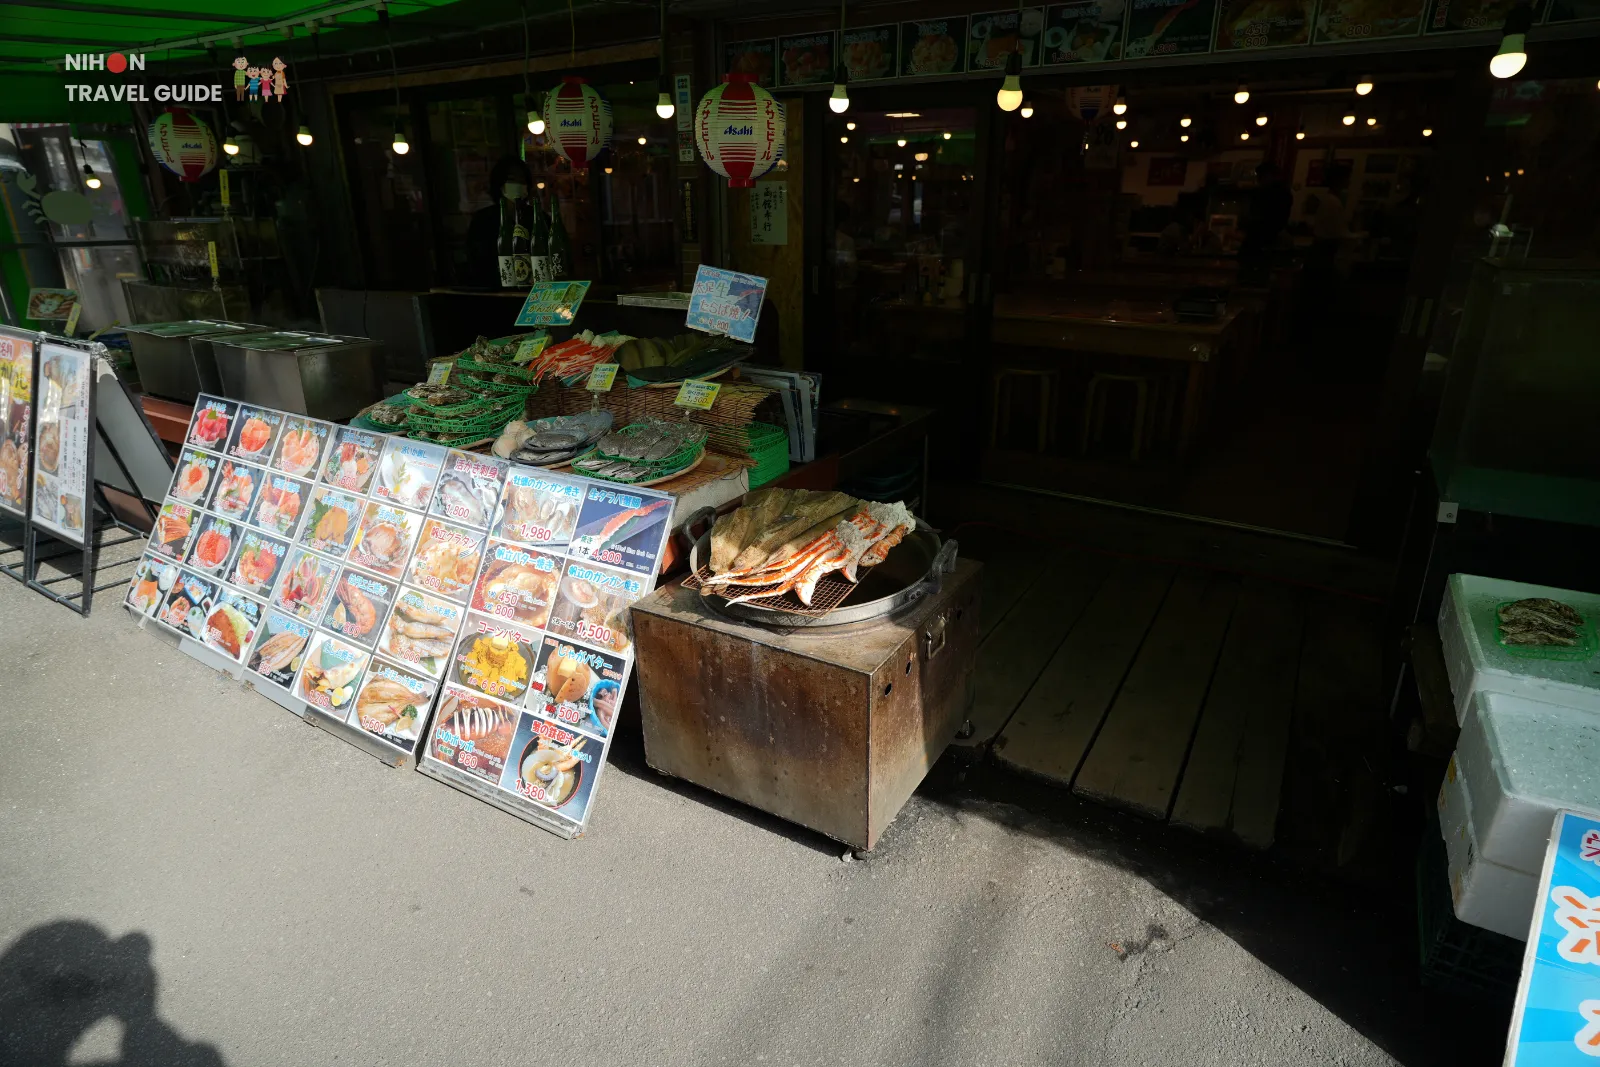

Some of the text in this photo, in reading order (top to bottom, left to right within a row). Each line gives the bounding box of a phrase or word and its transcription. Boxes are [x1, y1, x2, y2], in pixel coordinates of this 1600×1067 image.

[1245, 24, 1270, 36] 450
[1346, 25, 1371, 37] 800
[1464, 17, 1487, 27] 980
[1245, 35, 1268, 47] 800
[560, 119, 582, 127] Asahi
[588, 96, 601, 145] アサヒビール
[701, 99, 715, 161] アサヒビール
[761, 99, 776, 161] アサヒビール
[724, 125, 753, 136] Asahi
[455, 458, 499, 479] 活かき刺身
[445, 504, 470, 519] 1,800
[431, 526, 478, 549] 帆立グラタン
[520, 524, 551, 541] 1,980
[494, 547, 555, 571] 帆立バター焼き
[578, 546, 622, 565] 1本 4,800
[424, 575, 441, 589] 800
[568, 564, 641, 592] 帆立のガンガン焼き
[498, 591, 519, 606] 450
[494, 604, 515, 619] 800
[477, 621, 532, 645] コーンバター
[576, 621, 612, 643] 1,500
[557, 644, 613, 671] じゃがバター
[558, 707, 580, 723] 500
[361, 715, 386, 735] 1,600
[436, 728, 475, 753] いかポッポ
[458, 752, 478, 768] 980
[515, 778, 546, 801] 1,380
